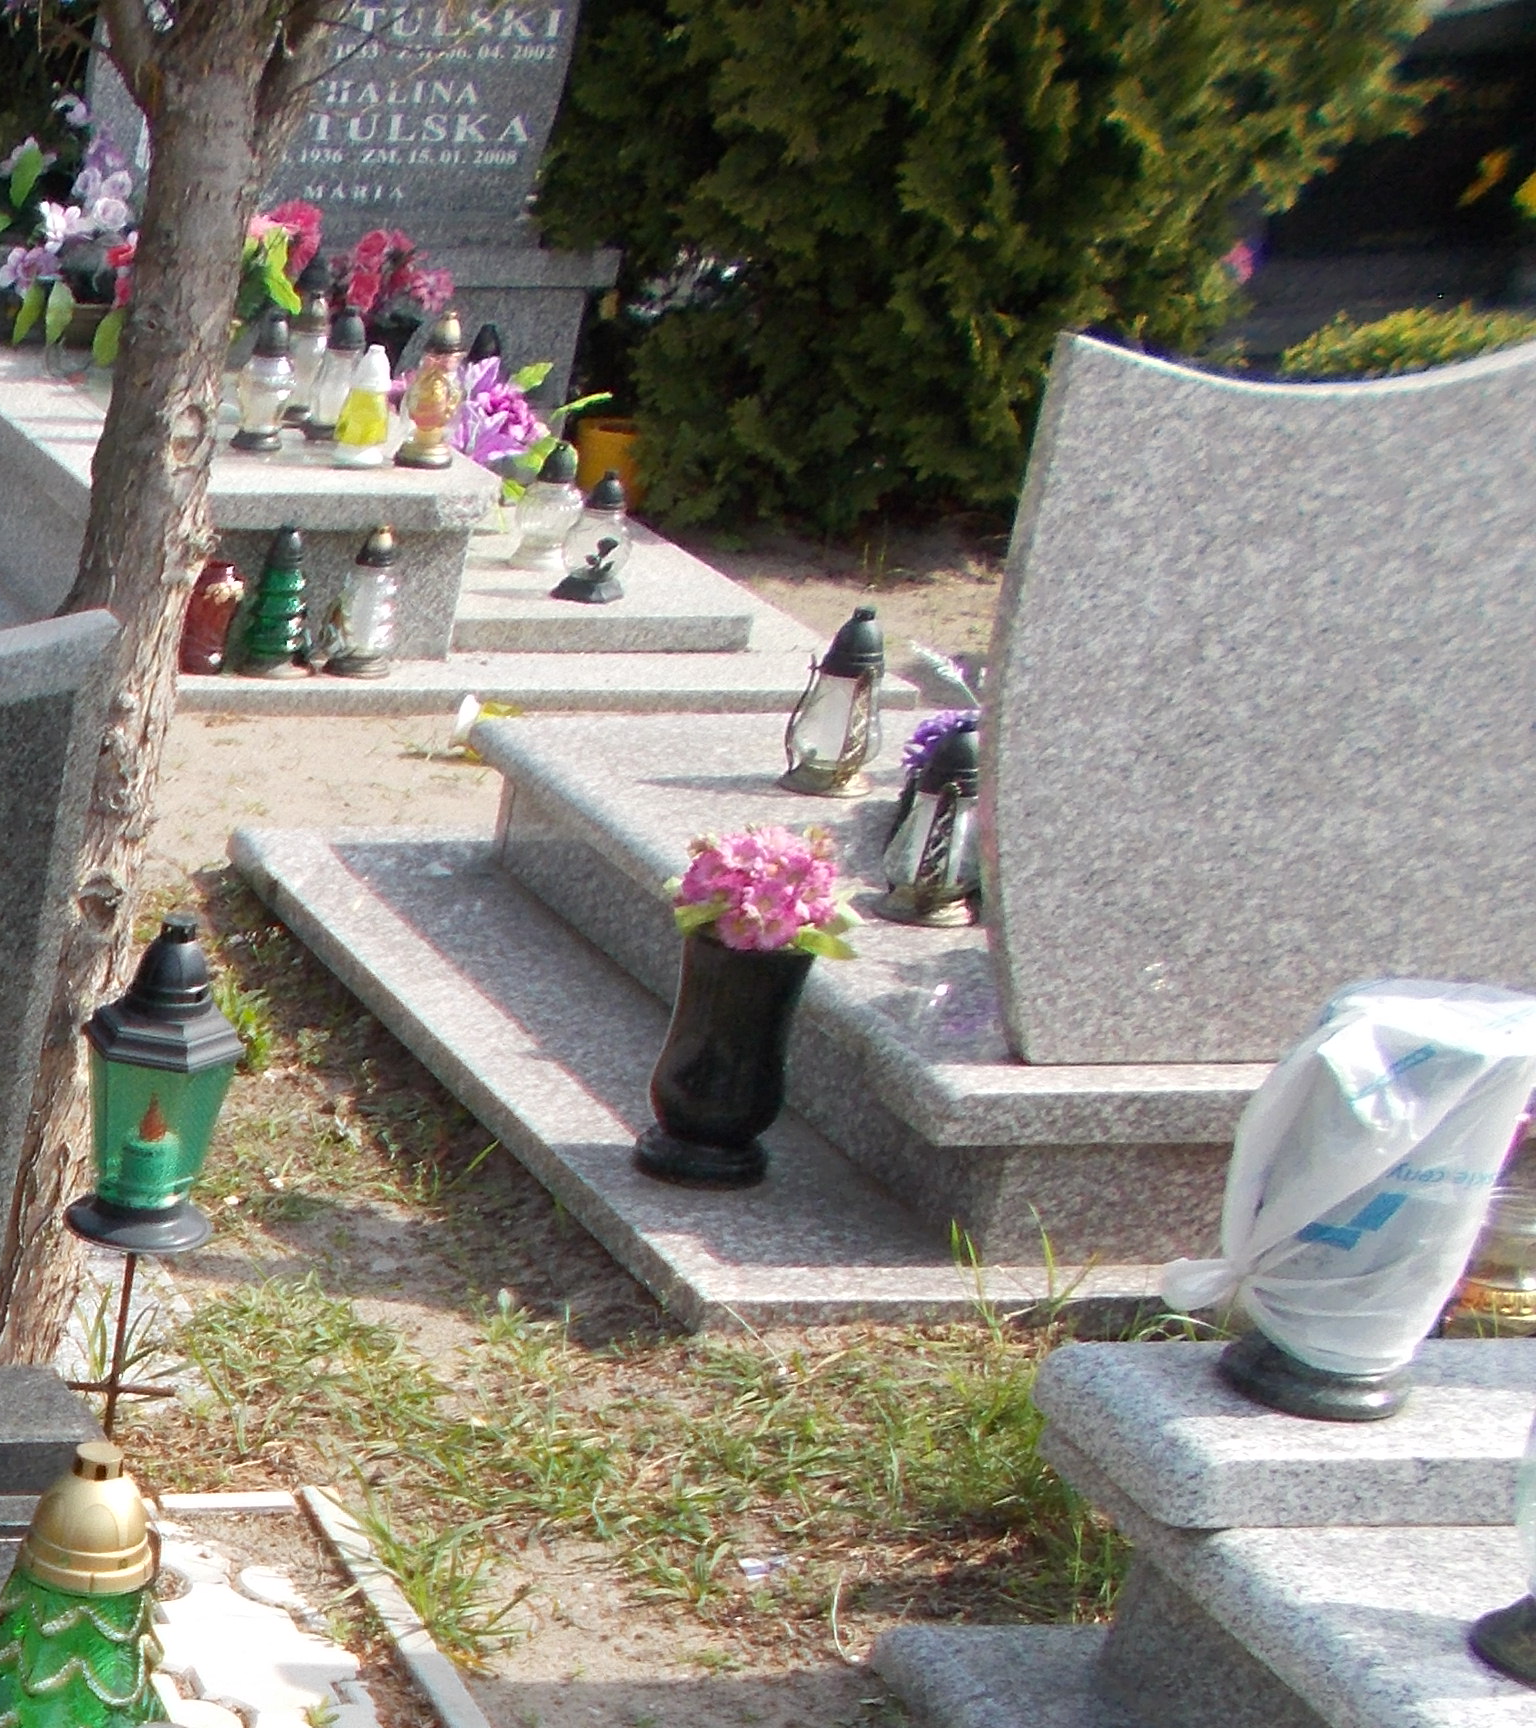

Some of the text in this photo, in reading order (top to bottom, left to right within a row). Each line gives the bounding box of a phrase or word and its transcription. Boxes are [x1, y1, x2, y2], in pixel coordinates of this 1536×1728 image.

[354, 7, 565, 37] TULSKI
[309, 113, 530, 143] TULSKA
[302, 183, 405, 201] MARIA
